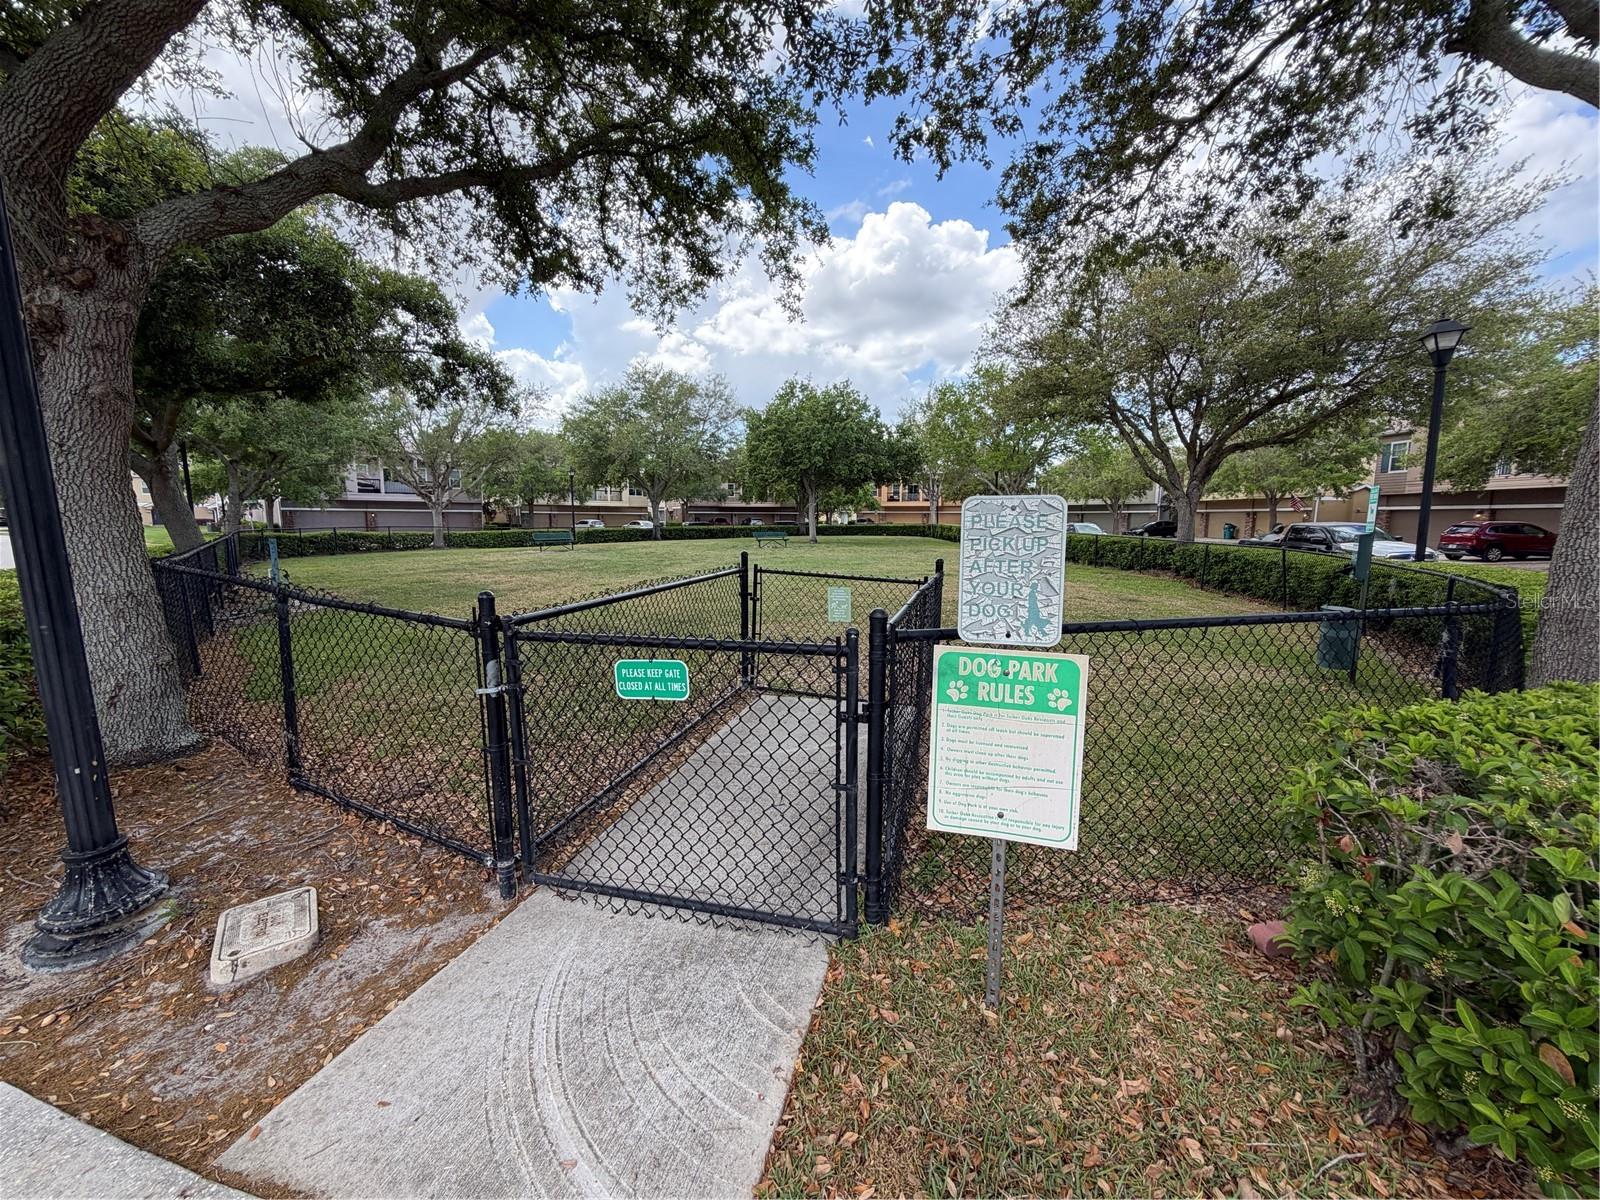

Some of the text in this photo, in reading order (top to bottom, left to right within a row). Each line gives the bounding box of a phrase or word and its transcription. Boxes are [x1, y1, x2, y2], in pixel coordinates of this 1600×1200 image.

[972, 514, 1048, 529] PLEASE
[970, 537, 1049, 551] PICK UP
[970, 559, 1033, 574] AFTER
[969, 581, 1024, 596] YOUR
[969, 603, 1012, 618] DOG
[622, 668, 680, 678] PLEASE KEEP GATE
[958, 656, 1060, 684] DOG PARK
[619, 682, 686, 692] CLOSED AT ALL TIMES
[978, 682, 1035, 705] RULES
